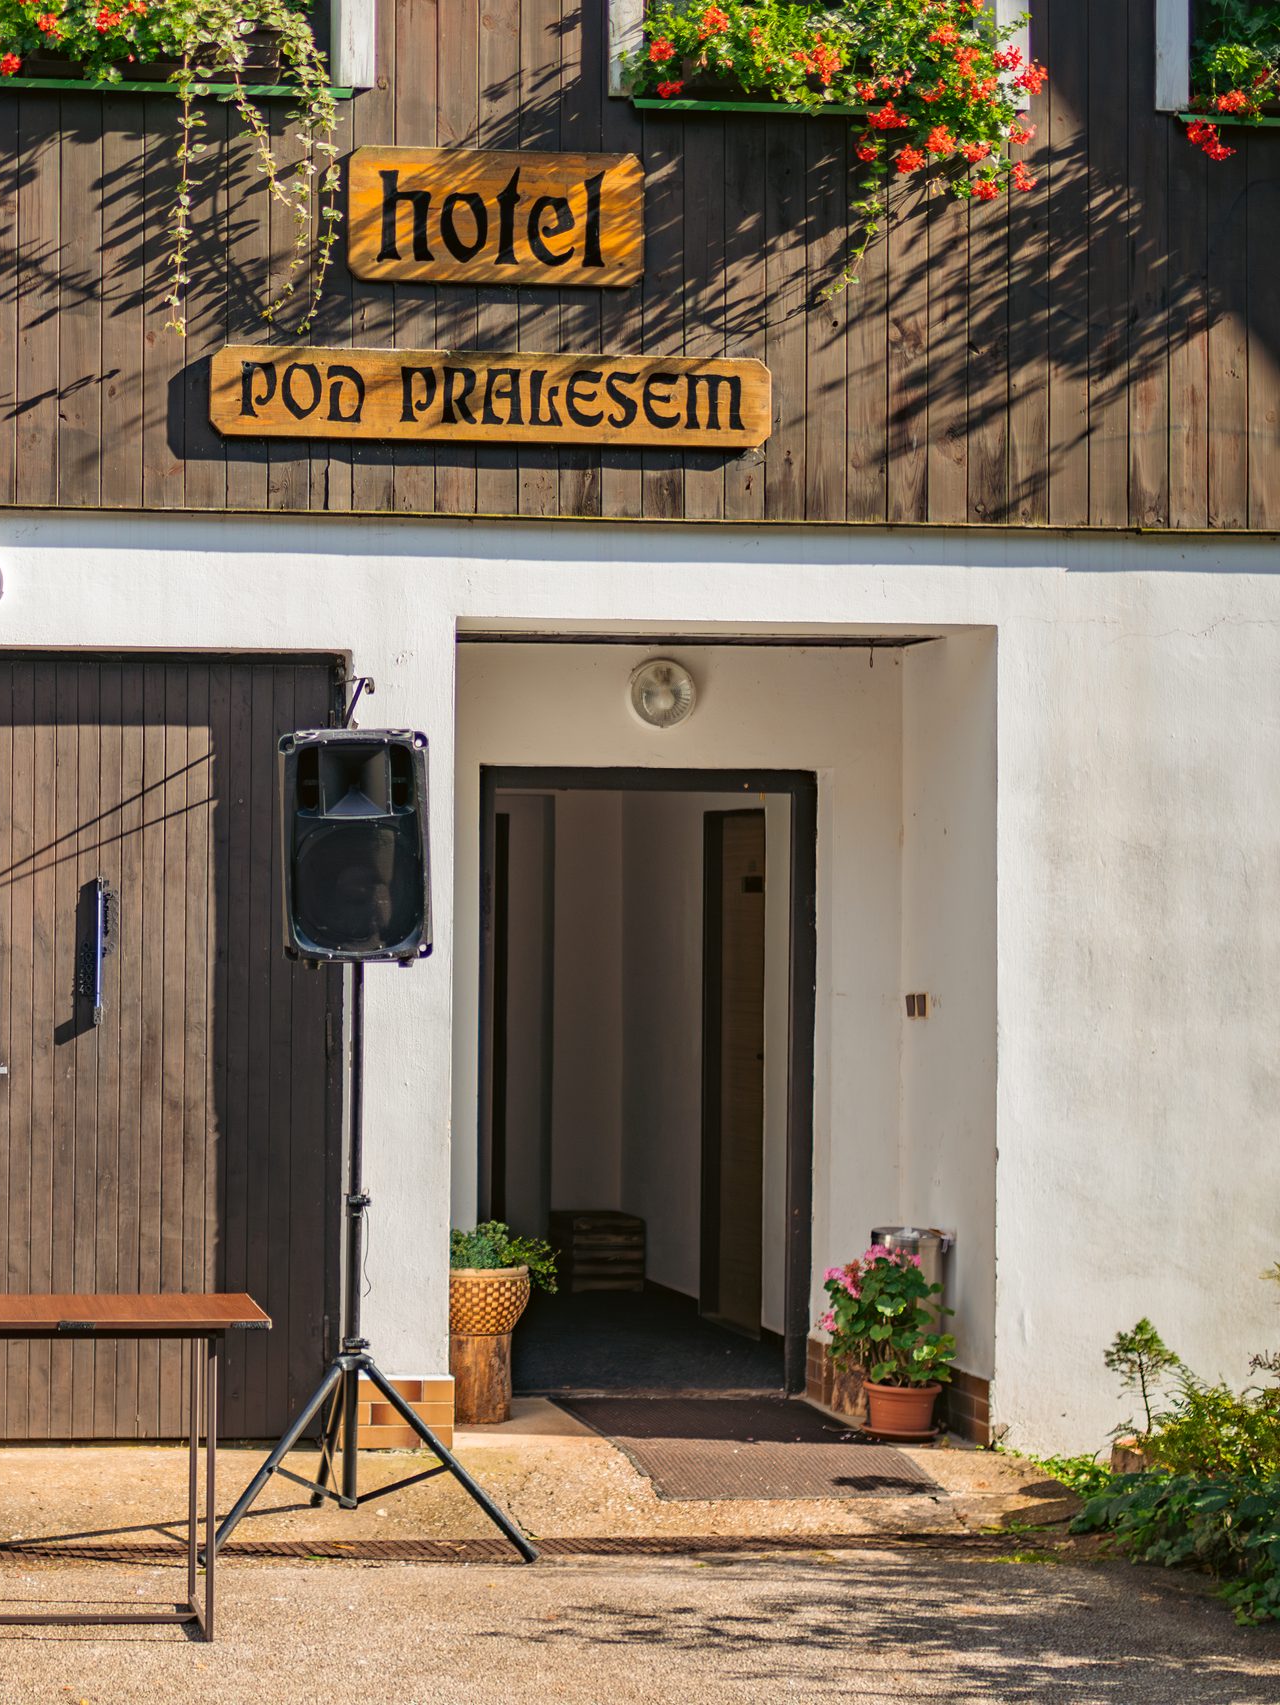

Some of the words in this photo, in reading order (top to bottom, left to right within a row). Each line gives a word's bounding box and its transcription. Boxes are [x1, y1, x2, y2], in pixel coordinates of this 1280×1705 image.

[376, 166, 605, 268] hotel
[239, 361, 366, 423] POD
[400, 365, 746, 430] PRALESEM
